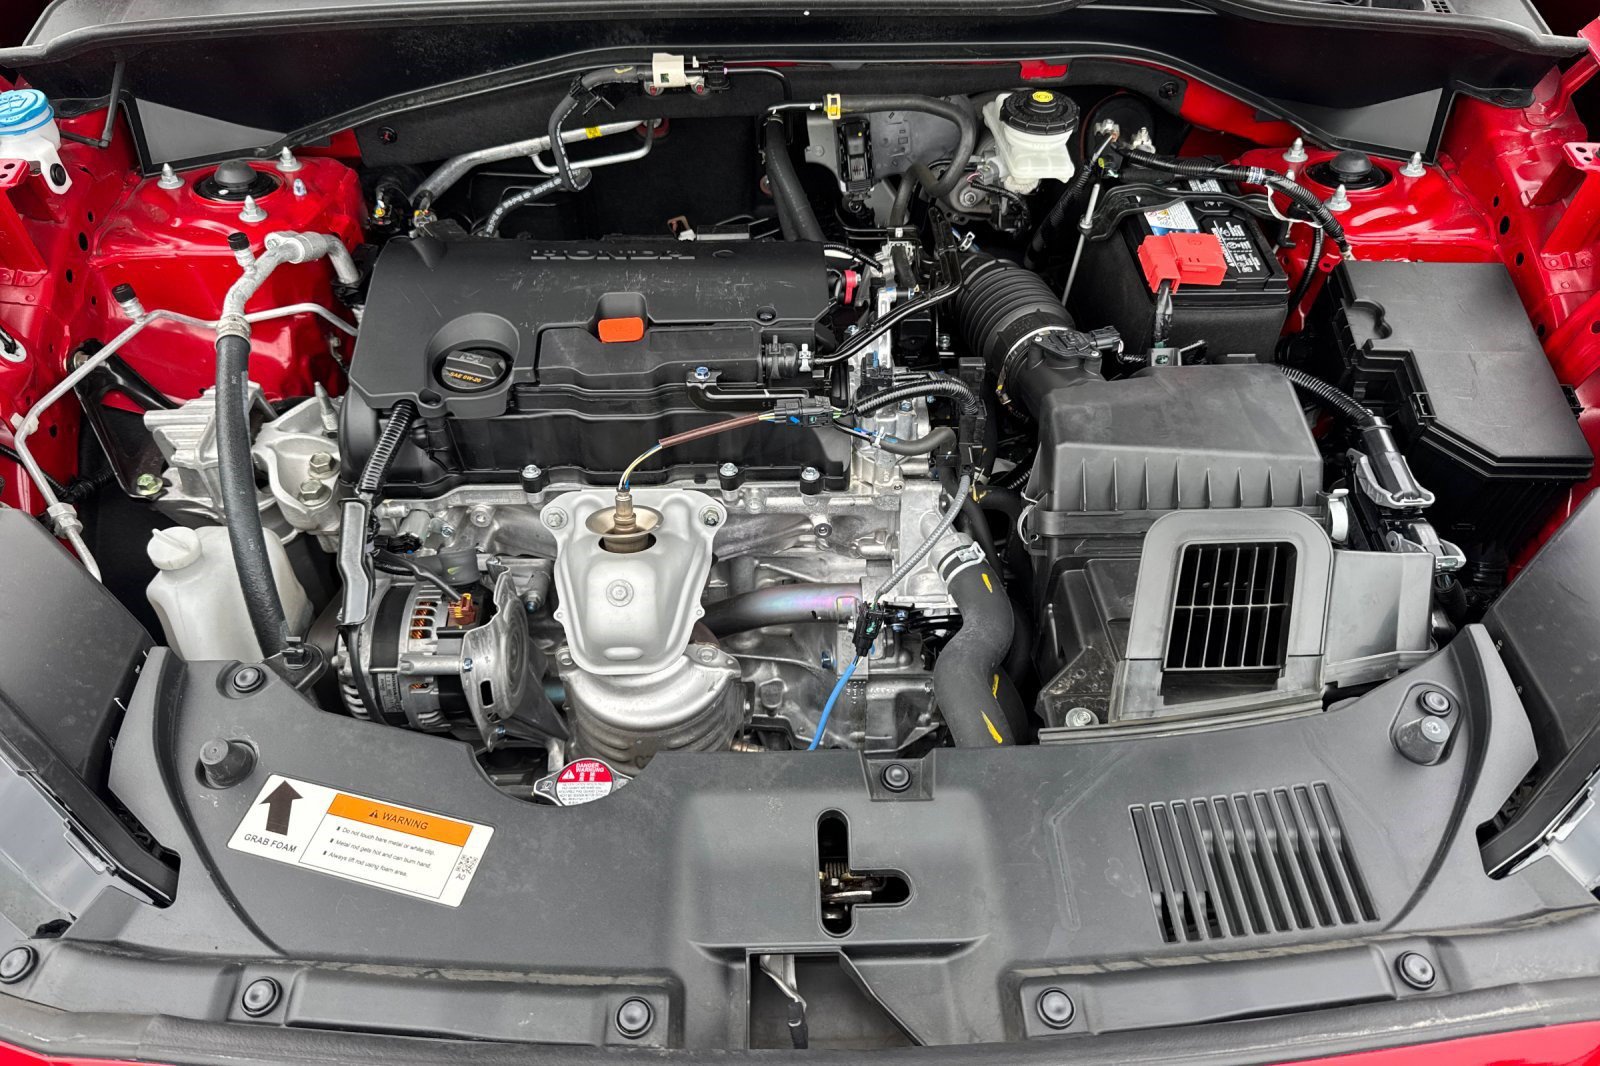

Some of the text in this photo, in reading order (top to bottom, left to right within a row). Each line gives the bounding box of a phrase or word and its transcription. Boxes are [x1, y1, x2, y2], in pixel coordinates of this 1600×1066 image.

[449, 371, 482, 383] SAE 0W-20
[382, 812, 429, 830] WARNING
[244, 833, 298, 853] GRAB FOAM
[360, 832, 375, 841] touch
[375, 836, 388, 844] bare
[388, 839, 404, 847] metal
[410, 844, 425, 852] white
[327, 851, 348, 861] Always
[364, 861, 380, 871] using
[381, 851, 393, 859] and
